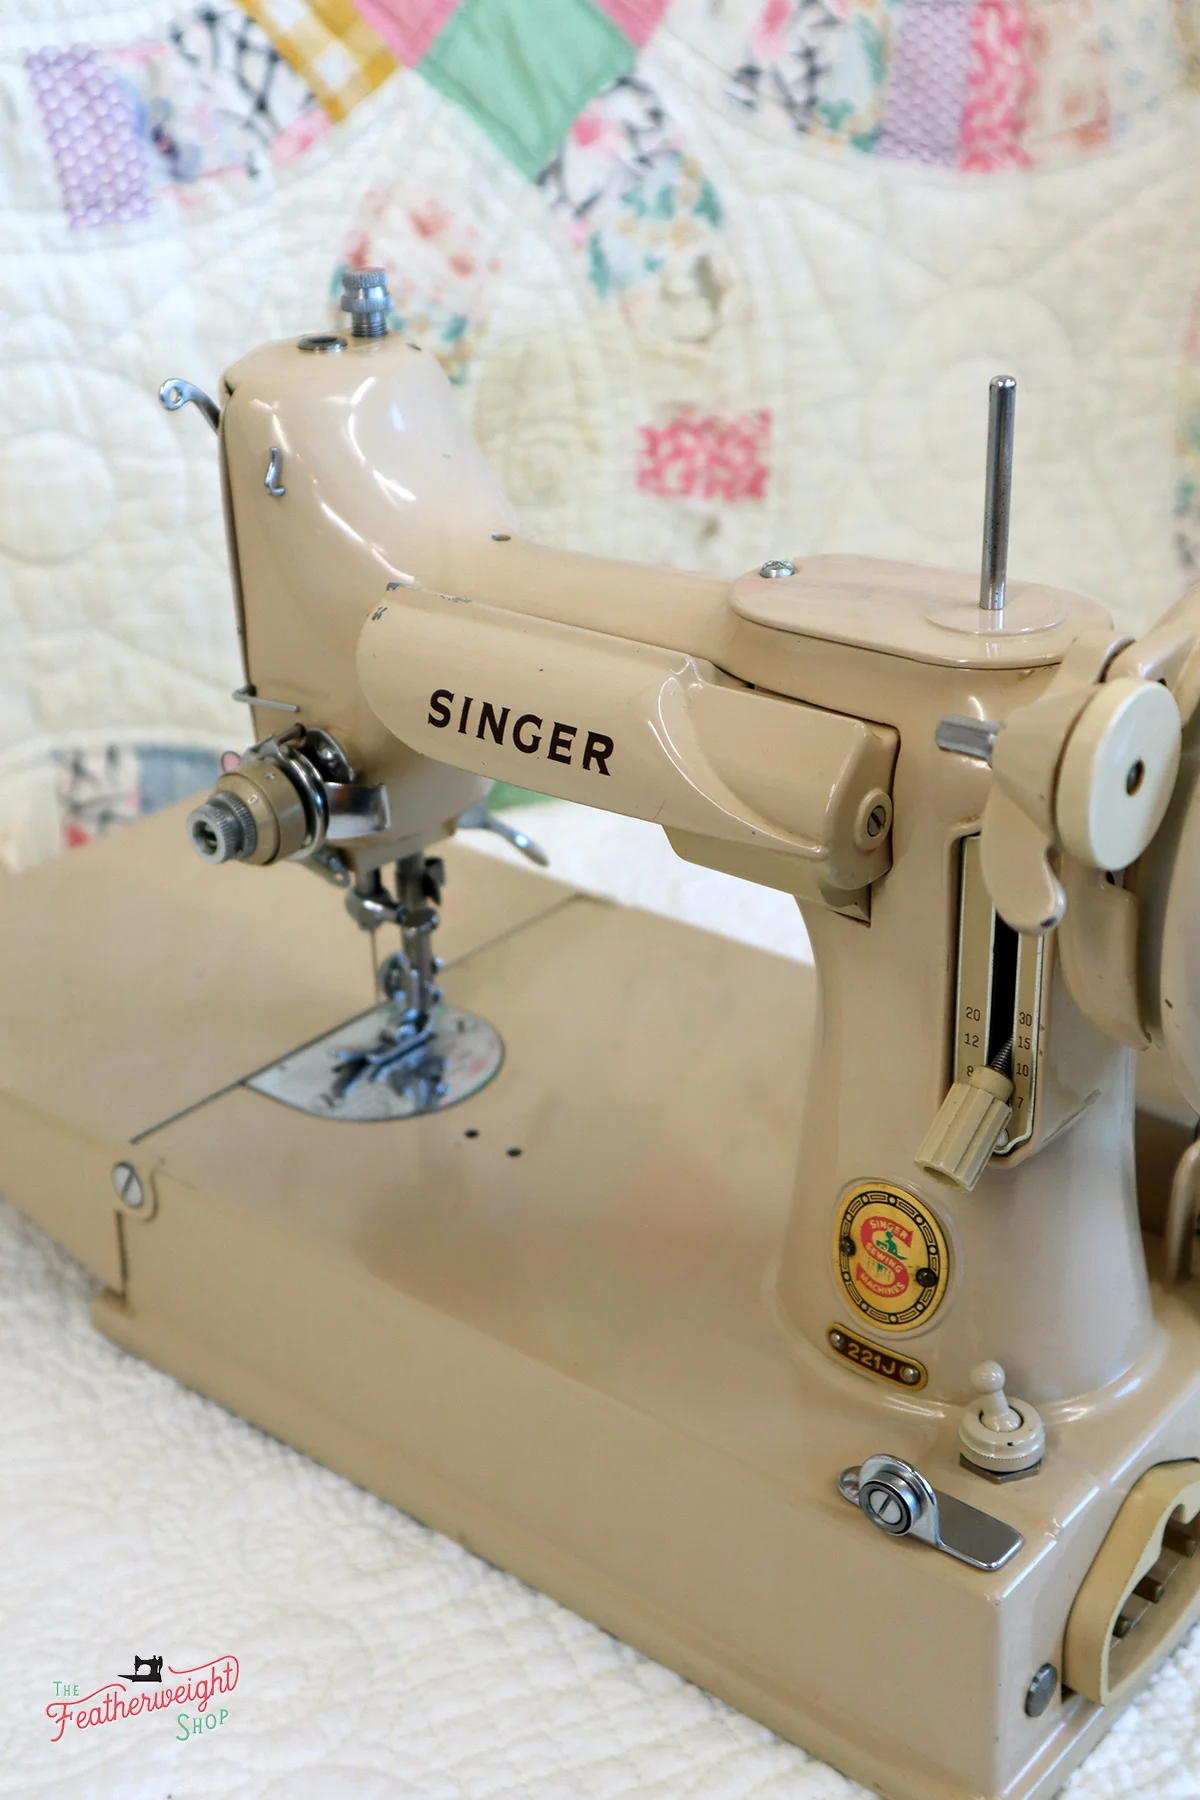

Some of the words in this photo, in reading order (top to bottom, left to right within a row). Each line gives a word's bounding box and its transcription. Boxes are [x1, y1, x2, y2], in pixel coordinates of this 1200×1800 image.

[428, 689, 614, 776] SINGER
[965, 1006, 981, 1022] 20
[1019, 1011, 1032, 1027] 30
[964, 1032, 980, 1048] 12
[1017, 1036, 1031, 1051] 15
[1016, 1063, 1029, 1077] 10
[1017, 1096, 1024, 1109] 7
[869, 1219, 909, 1240] SINGER
[865, 1242, 904, 1273] SEWING
[860, 1272, 906, 1296] MACHINES
[847, 1342, 896, 1375] 221J
